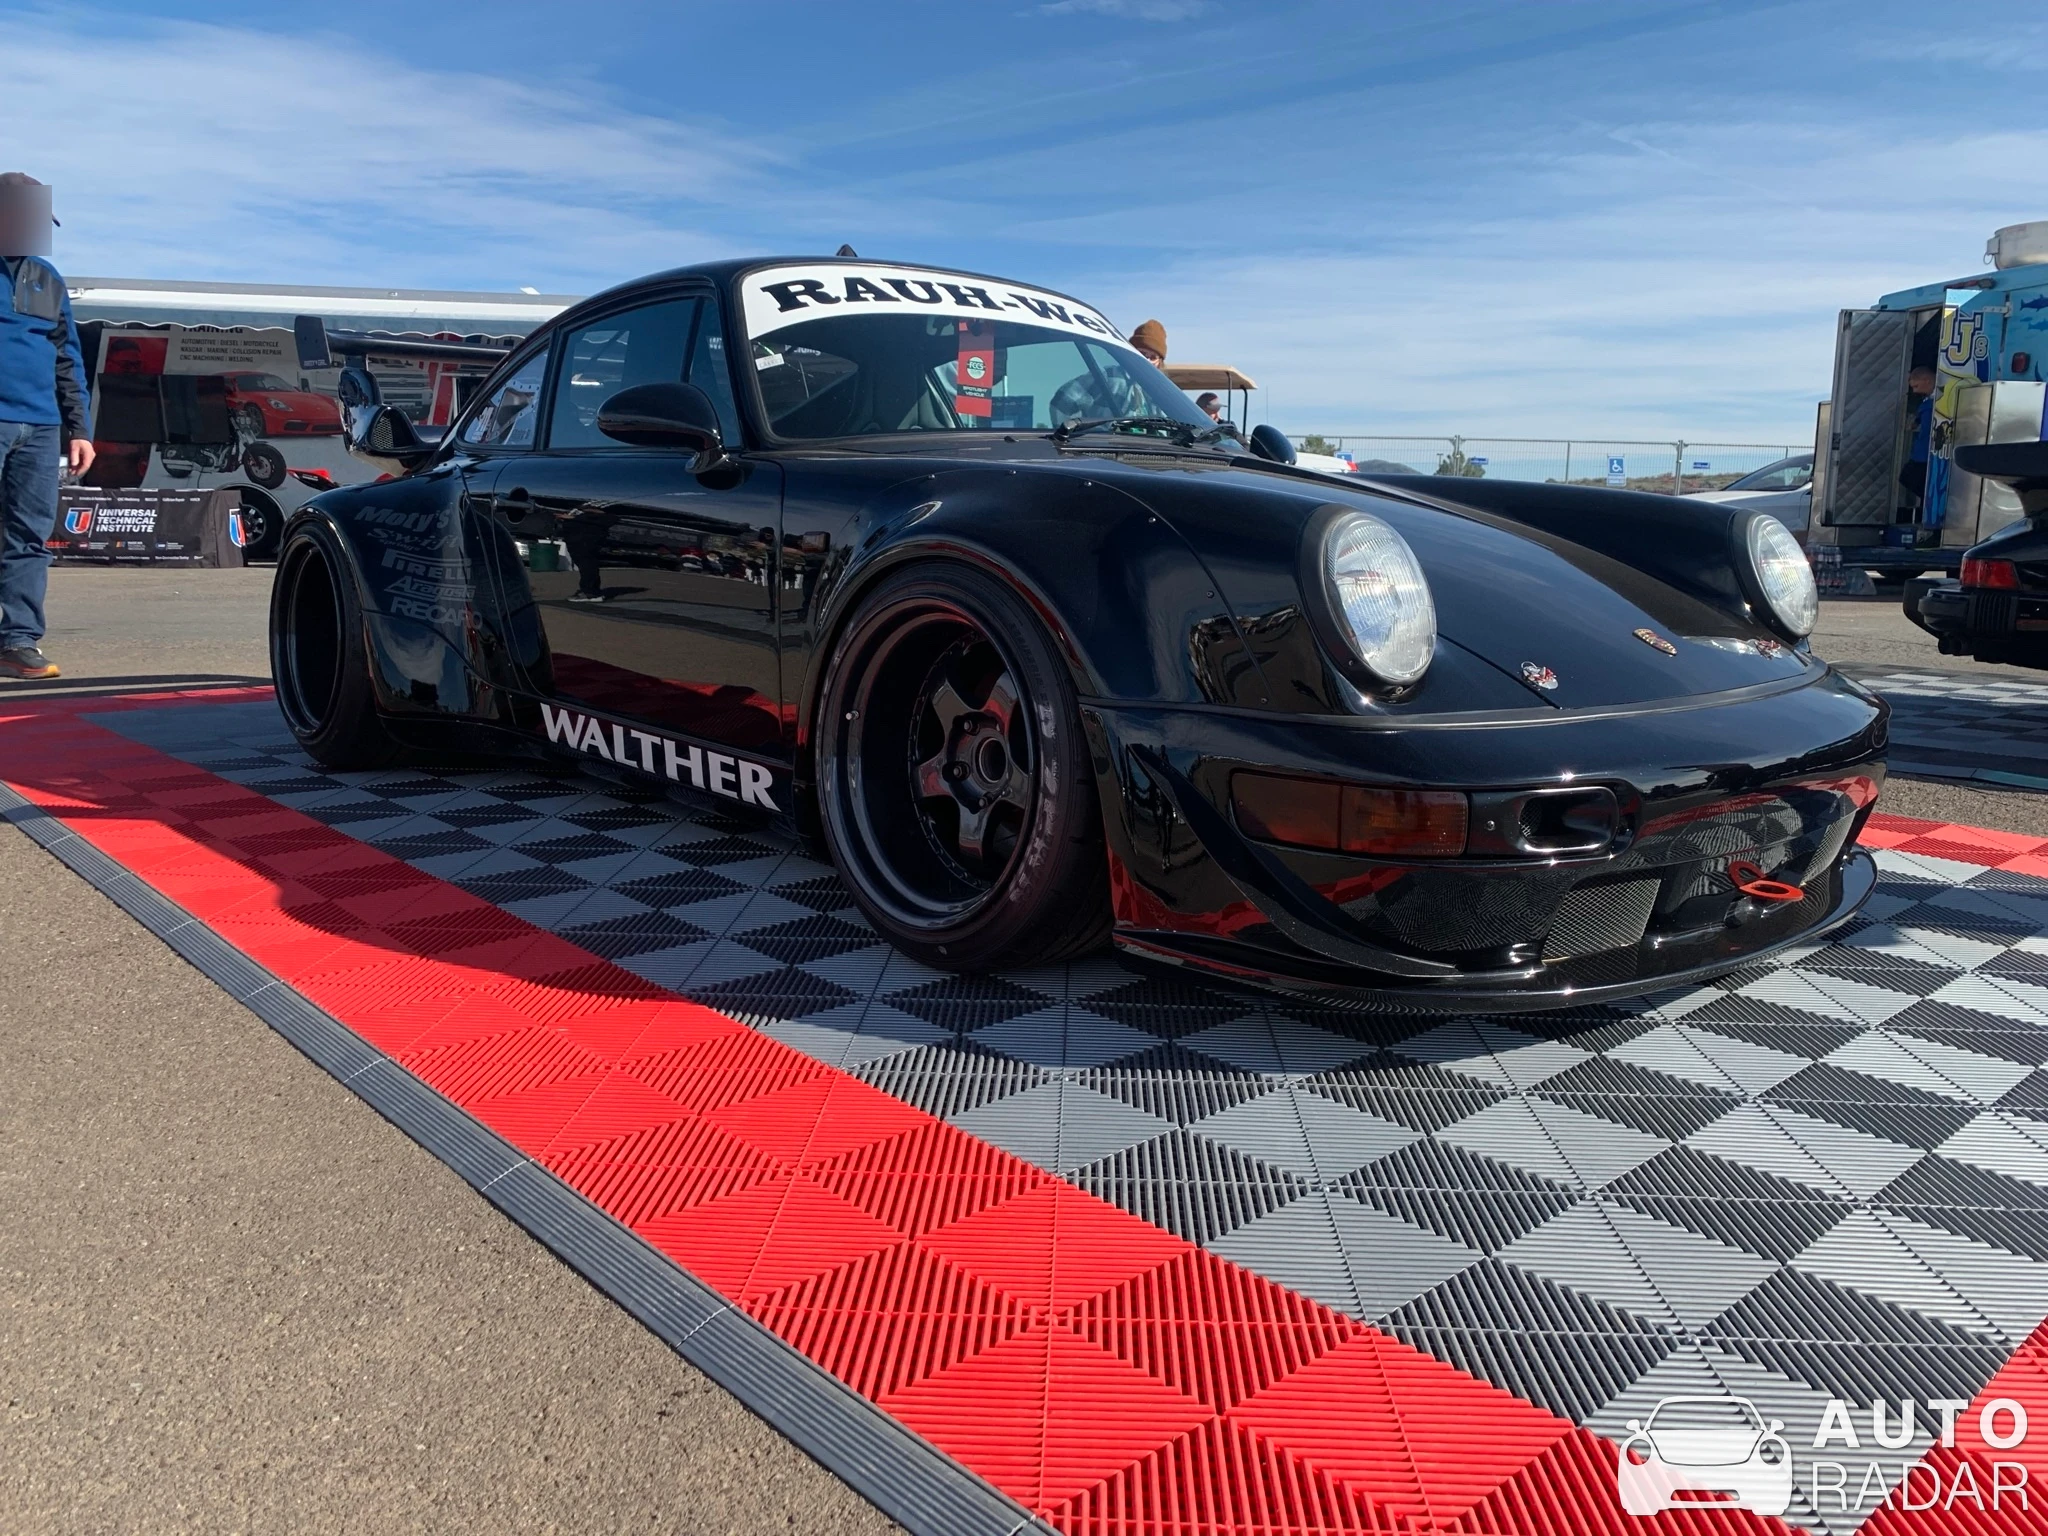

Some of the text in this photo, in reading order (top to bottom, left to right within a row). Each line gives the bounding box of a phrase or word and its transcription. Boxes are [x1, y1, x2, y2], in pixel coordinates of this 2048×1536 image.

[760, 276, 1127, 344] RAUH-Wel
[181, 338, 216, 346] AUTOMOTIVE
[243, 340, 279, 348] MOTORCYCLE
[97, 516, 156, 525] TECHNICAL
[98, 509, 158, 517] UNIVERSAL
[355, 505, 453, 533] Moty's
[96, 524, 154, 533] INSTITUTE
[381, 547, 472, 580] PIRELLI
[390, 596, 483, 630] RECARO
[540, 702, 782, 812] WALTHER
